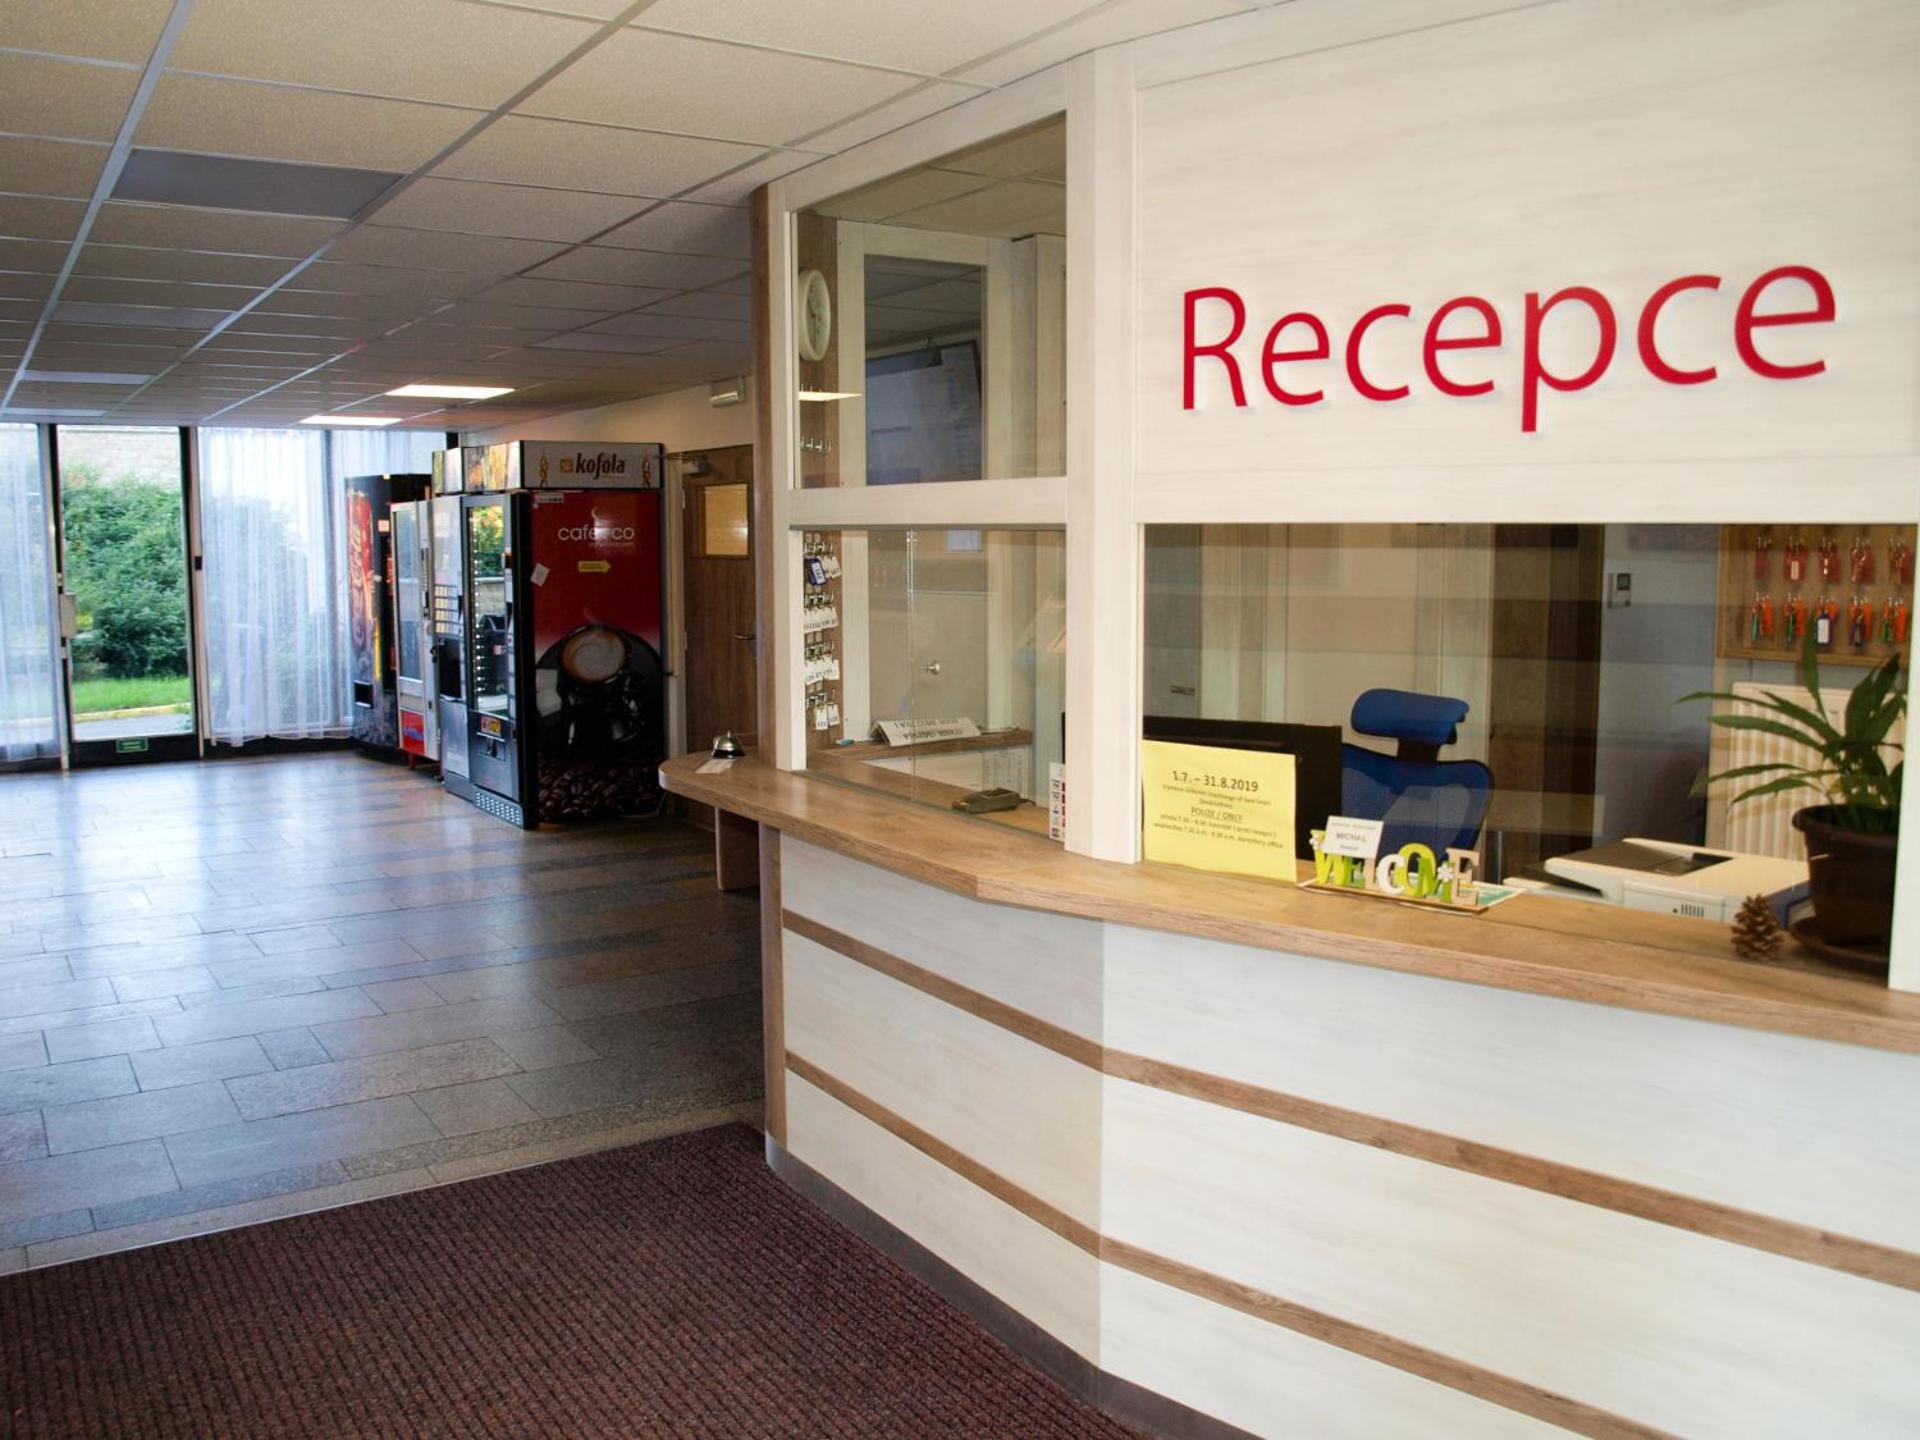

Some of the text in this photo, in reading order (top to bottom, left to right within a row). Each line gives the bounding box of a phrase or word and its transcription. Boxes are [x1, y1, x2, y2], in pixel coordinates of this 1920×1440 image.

[1183, 265, 1836, 433] Recepce
[576, 452, 626, 480] kofola
[1203, 775, 1259, 793] 31.8.2019
